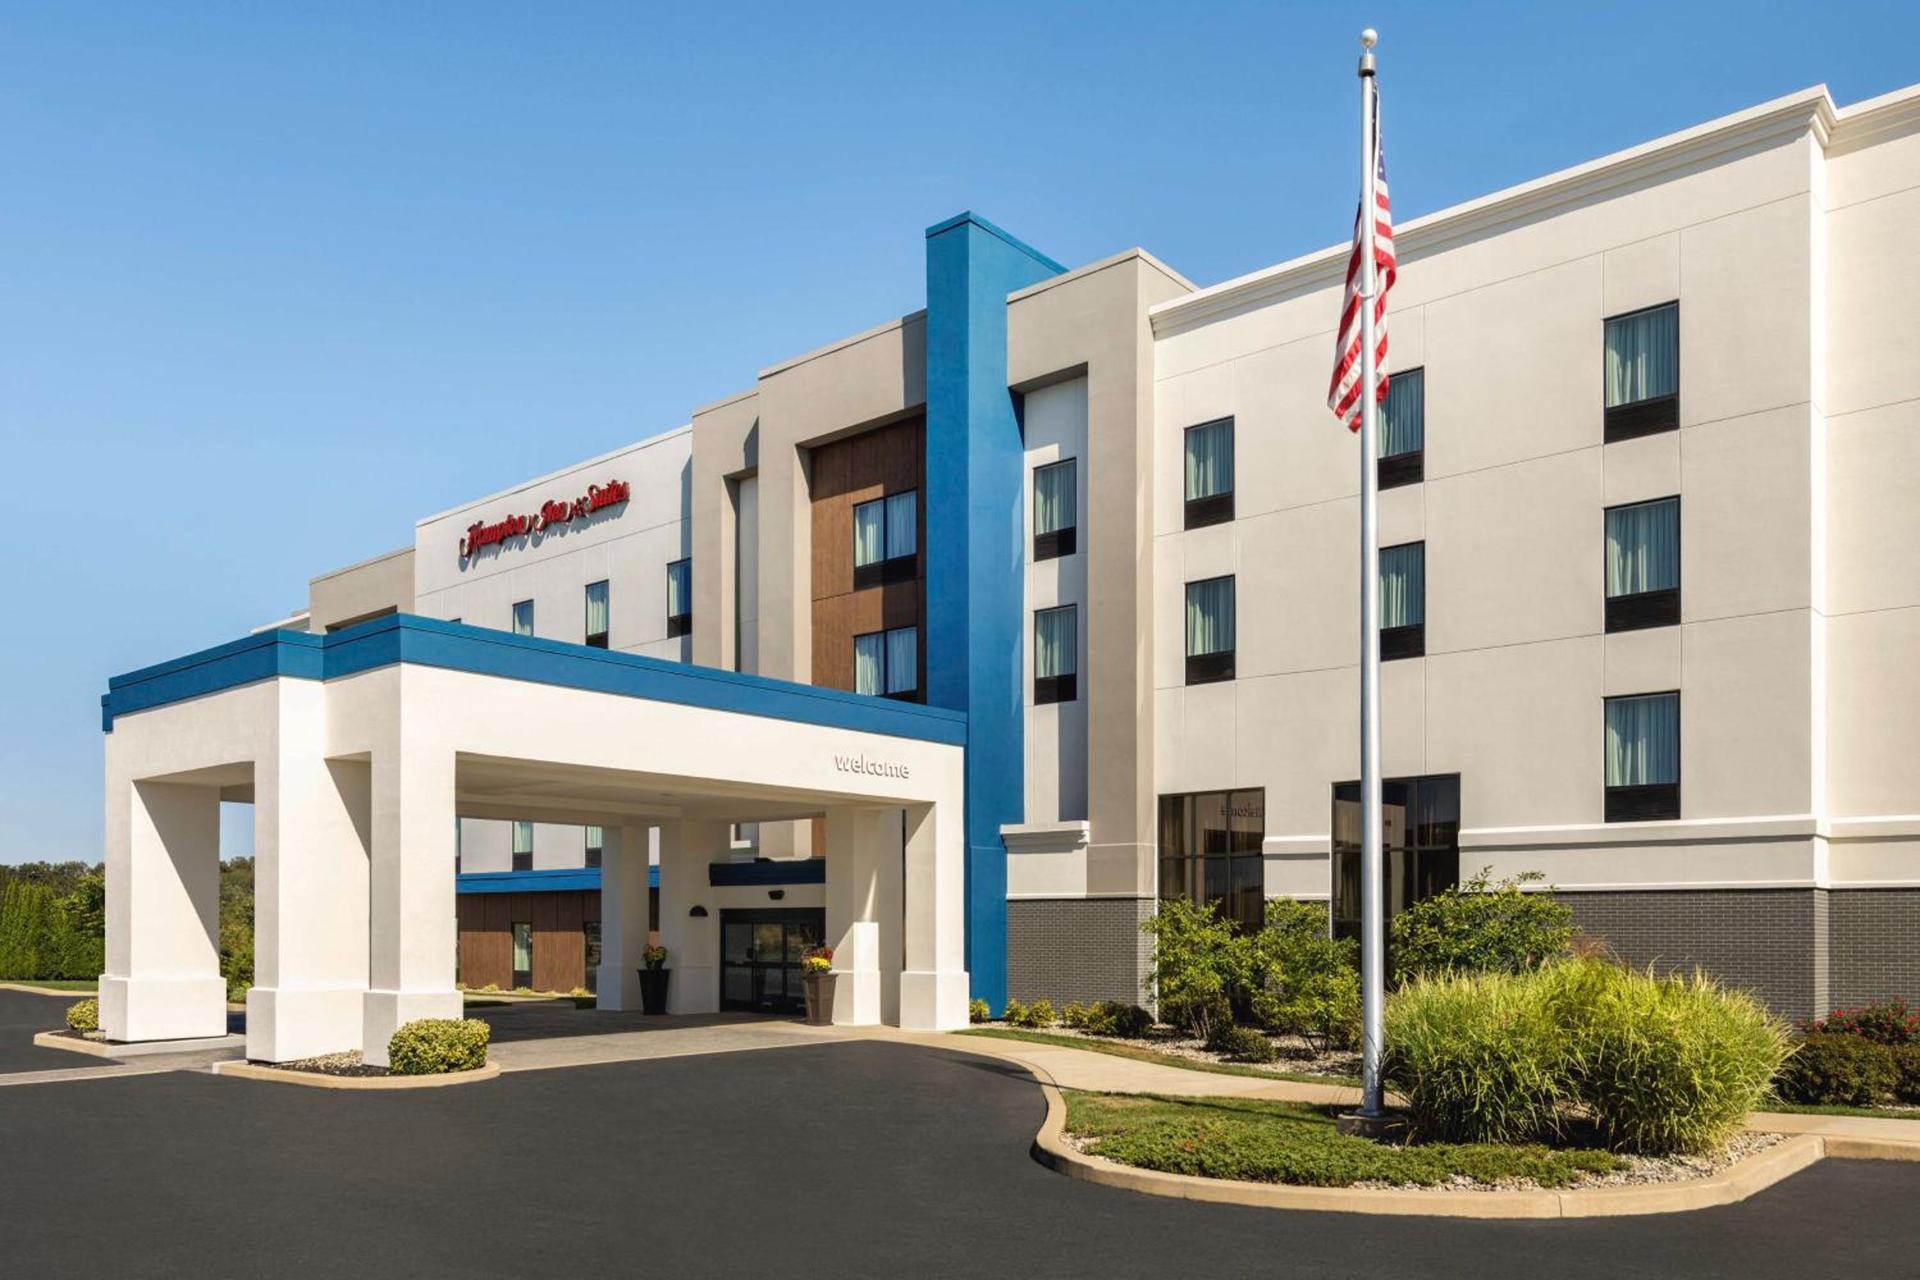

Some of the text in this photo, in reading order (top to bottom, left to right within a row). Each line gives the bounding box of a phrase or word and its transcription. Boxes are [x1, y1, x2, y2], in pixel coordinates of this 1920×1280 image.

[459, 514, 533, 558] Hampton
[583, 480, 630, 515] Suites
[834, 753, 910, 779] welcome
